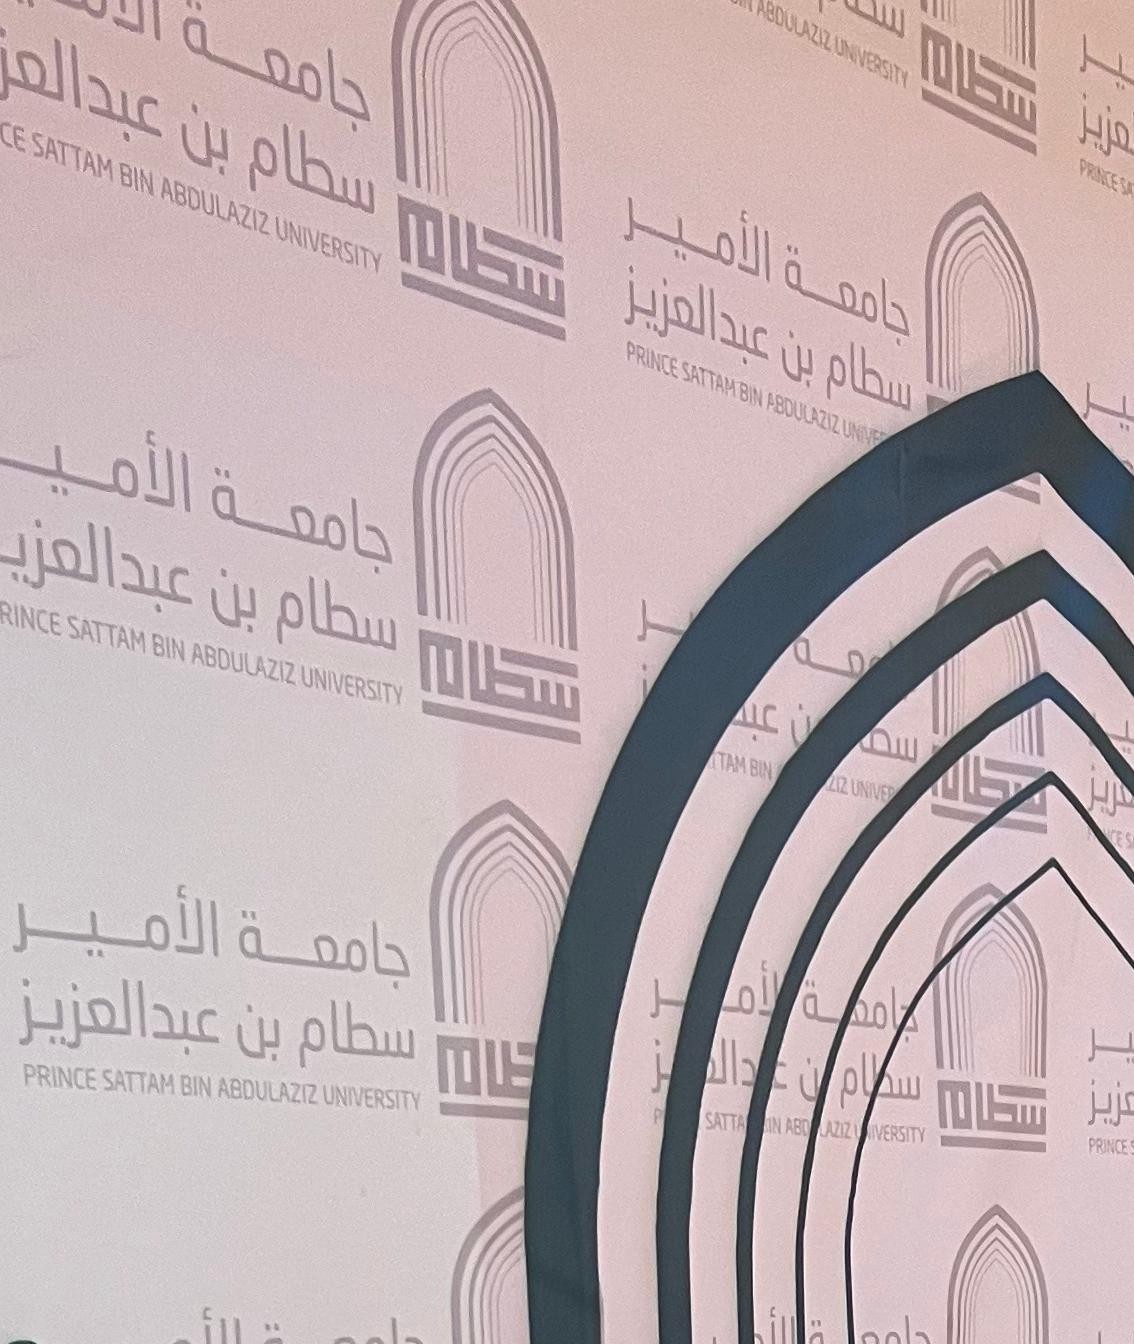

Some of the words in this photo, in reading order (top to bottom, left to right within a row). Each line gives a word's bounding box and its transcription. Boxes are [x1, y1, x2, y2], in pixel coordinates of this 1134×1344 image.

[181, 0, 370, 133] جامعة
[757, 3, 831, 51] ABDULAZIZ
[834, 38, 909, 89] UNIVERSITY
[179, 102, 229, 176] بن
[248, 123, 375, 215] سطام
[31, 131, 115, 182] SATTAM
[118, 161, 155, 196] BIN
[159, 177, 272, 237] ABDULAZIZ
[275, 217, 382, 272] UNIVERSITY
[621, 196, 770, 282] الأمير
[623, 263, 769, 365] عبدالعزيز
[783, 243, 909, 345] جامعة
[625, 340, 680, 379] PRINCE
[682, 360, 737, 398] SATTAM
[738, 380, 764, 408] BIN
[765, 390, 841, 435] ABDULAZIZ
[780, 329, 813, 387] بن
[825, 341, 911, 412] سطام
[0, 423, 191, 514] الأمي
[0, 505, 192, 614] عبدالعزي
[210, 466, 392, 575] جامعة
[209, 566, 256, 633] بن
[275, 574, 397, 651] سطام
[0, 596, 64, 637] RINCE
[67, 614, 147, 653] SATTAM
[150, 632, 186, 662] BIN
[190, 641, 298, 685] ABDULAZIZ
[300, 665, 404, 704] UNIVERSITY
[11, 883, 219, 958] الأمير
[237, 909, 411, 990] جامعة
[18, 977, 220, 1056] عبدالعزيز
[235, 1003, 280, 1062] بن
[298, 998, 415, 1068] سطام
[799, 979, 920, 1042] جامعة
[22, 1062, 98, 1091] PRINCE
[101, 1068, 177, 1094] SATTAM
[179, 1073, 214, 1098] BIN
[217, 1077, 320, 1105] ABDULAZIZ
[322, 1085, 421, 1110] UNIVERSITY
[840, 1050, 923, 1109] سطام
